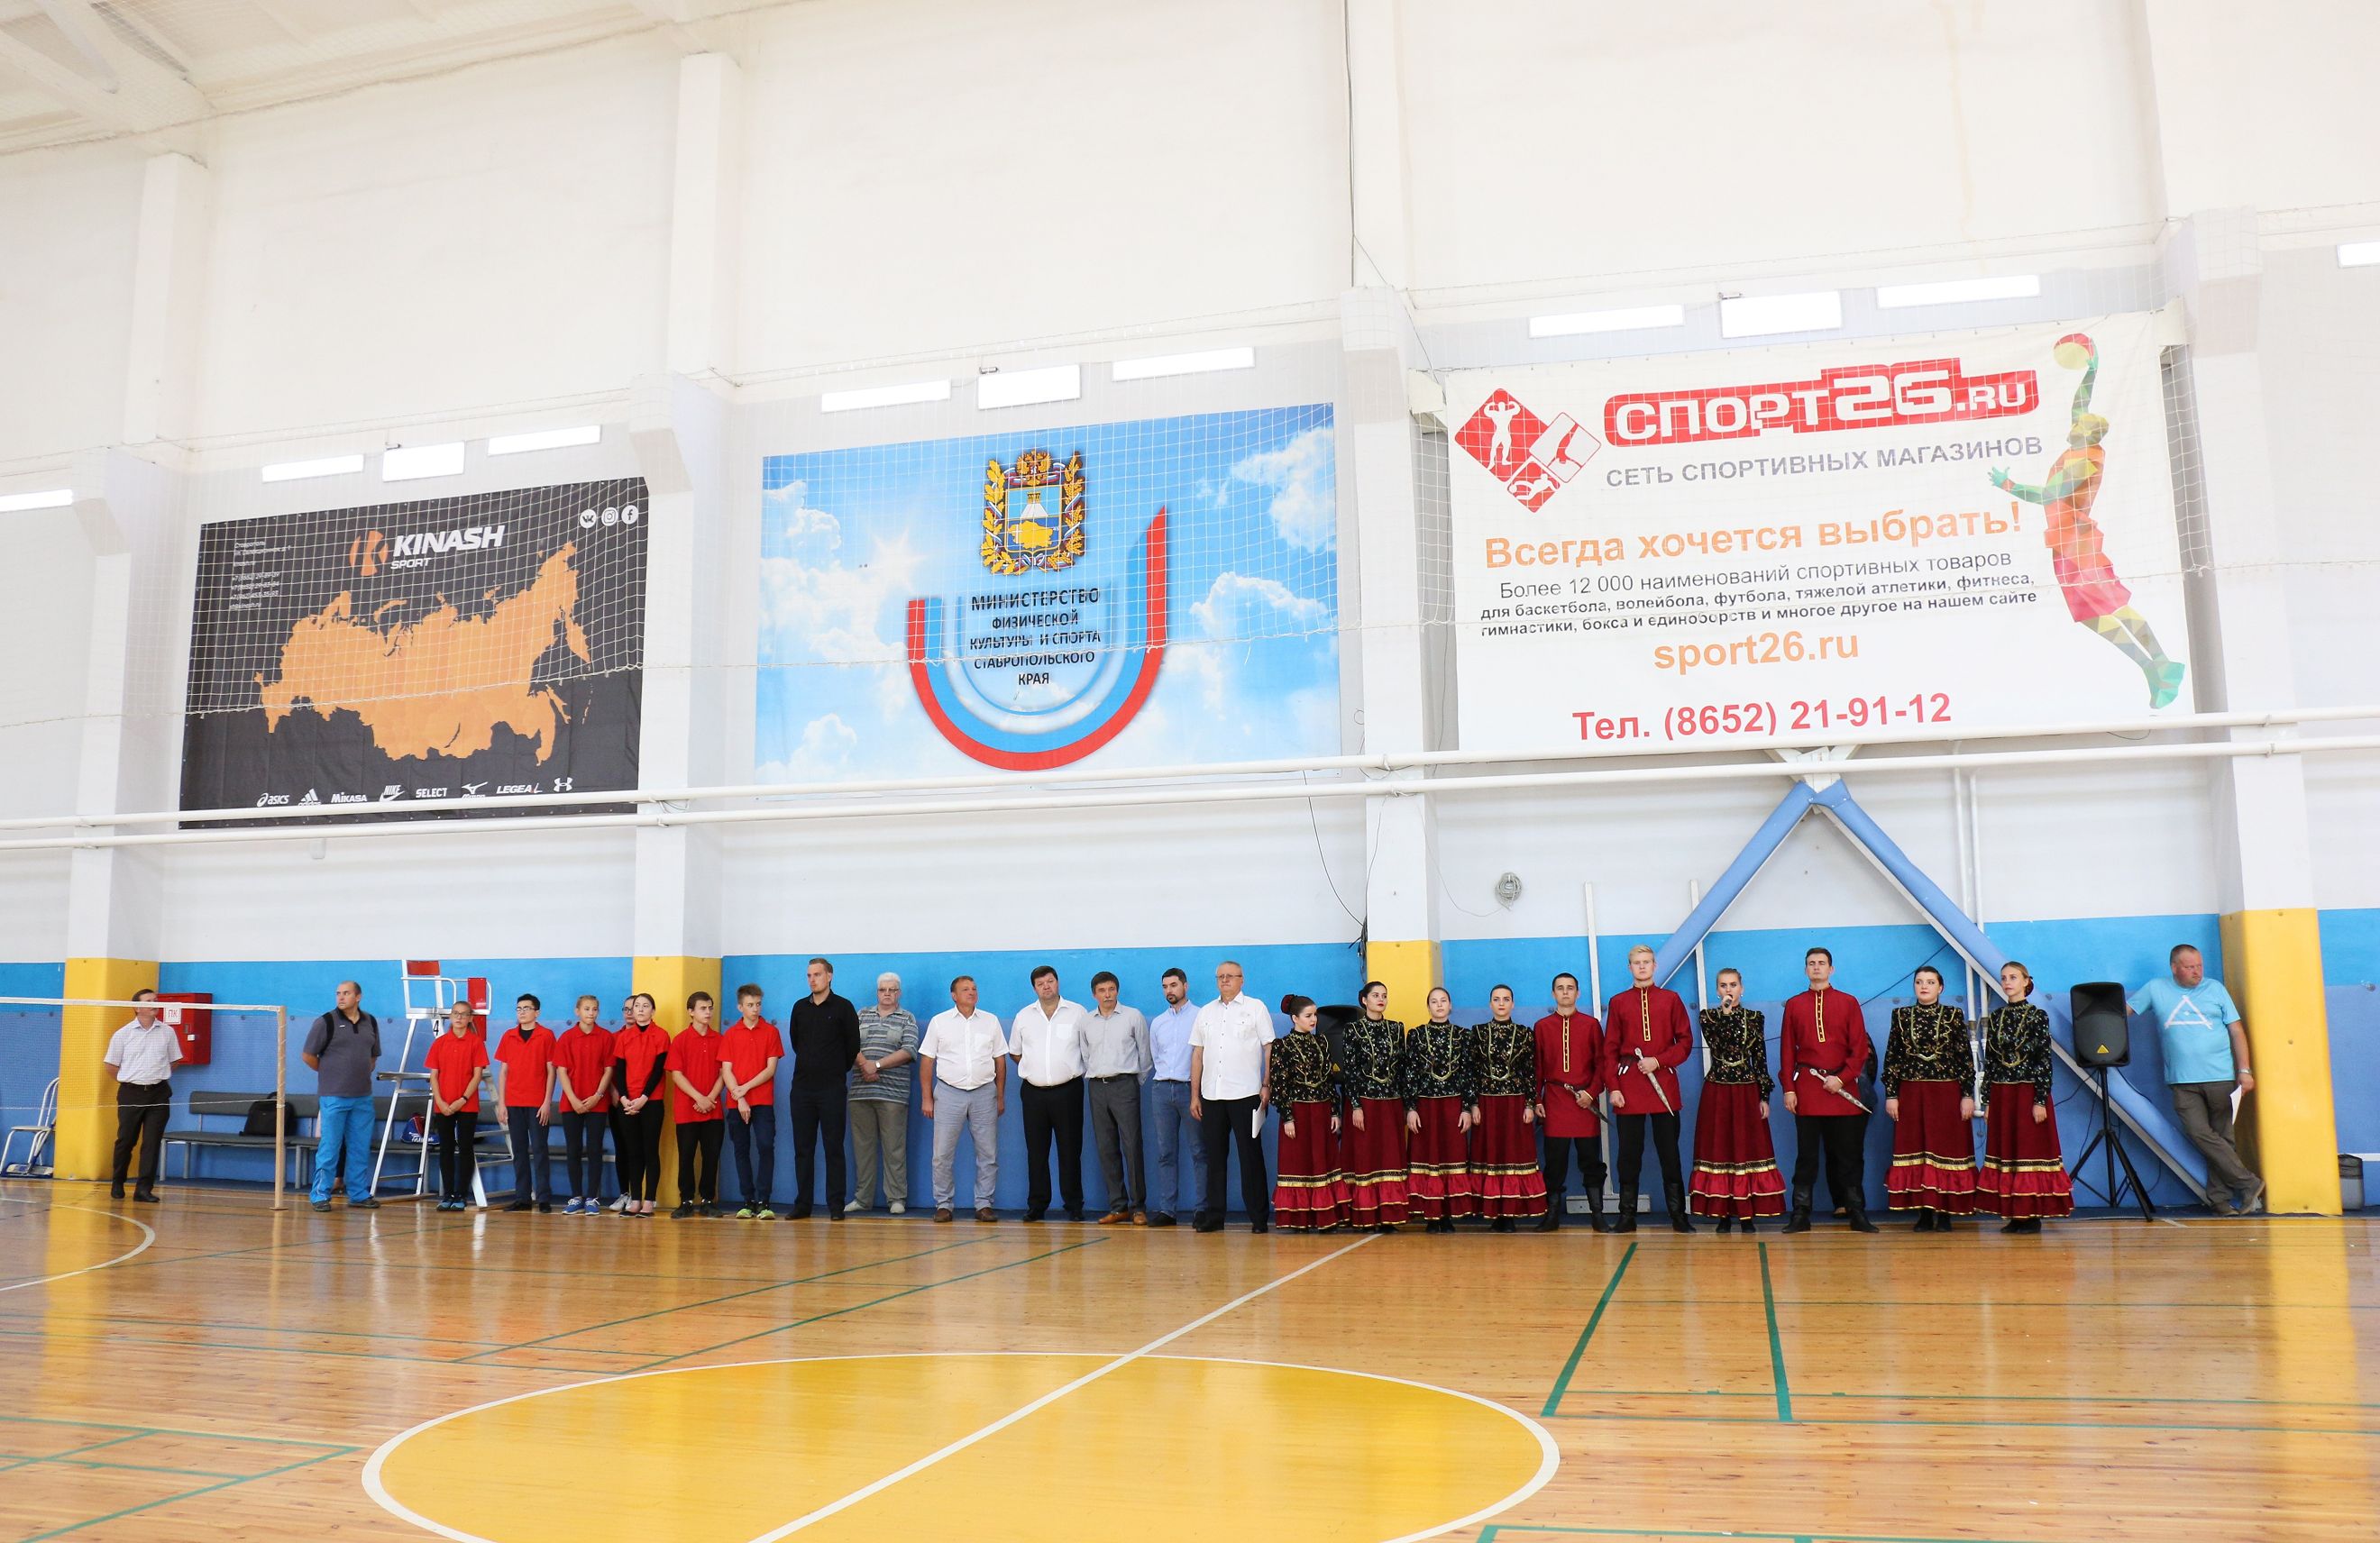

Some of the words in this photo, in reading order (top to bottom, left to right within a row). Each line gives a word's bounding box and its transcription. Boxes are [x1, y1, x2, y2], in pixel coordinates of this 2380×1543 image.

[1606, 466, 1673, 488] СЕТЬ
[1682, 451, 1869, 481] СПОРТИВНЫХ
[1877, 436, 2043, 468] МАГАЗИНОВ
[393, 525, 505, 557] KINASH
[1485, 535, 1625, 569] Всегда
[1638, 522, 1803, 559] хочется
[1818, 501, 2022, 549] выбрать!
[390, 557, 432, 570] SPORT
[1500, 582, 1561, 598] Более
[1570, 578, 1591, 594] 12
[1597, 575, 1634, 592] 000
[1641, 565, 1790, 589] наименований
[1797, 560, 1919, 581] спортивных
[1927, 552, 2011, 572] товаров
[972, 588, 1100, 611] МИНИСТЕРСТВО
[1481, 607, 1510, 620] для
[1515, 600, 1611, 617] баскетбола,
[1616, 594, 1709, 610] волейбола,
[1714, 589, 1790, 607] футбола,
[1796, 581, 1866, 600] тяжелой
[1872, 579, 1952, 595] атлетики,
[1957, 573, 2035, 590] фитнеса,
[993, 609, 1078, 629] ФИЗИЧЕСКОЙ
[1481, 619, 1578, 636] гимнастики,
[1582, 618, 1628, 630] бокса
[1634, 617, 1643, 627] и
[1648, 611, 1756, 627] единоборств
[1762, 610, 1771, 620] и
[1777, 605, 1835, 618] многое
[1841, 601, 1898, 616] другое
[1903, 599, 1922, 611] на
[1927, 595, 1983, 608] нашем
[1990, 590, 2037, 605] сайте
[970, 635, 1032, 650] КУЛЬТУРЫ
[1040, 634, 1048, 645] И
[1053, 631, 1101, 644] СПОРТА
[975, 651, 1094, 669] СТАВРОПОЛЬСКОГО
[1653, 631, 1859, 675] sport26.ru
[1019, 672, 1049, 685] КРАЯ
[1572, 709, 1649, 741] Тел.
[1664, 701, 1777, 742] (8652)
[1790, 693, 1952, 730] 21-91-12
[383, 785, 401, 795] NIKE
[416, 788, 448, 798] SELECT
[496, 785, 532, 794] LEGEA
